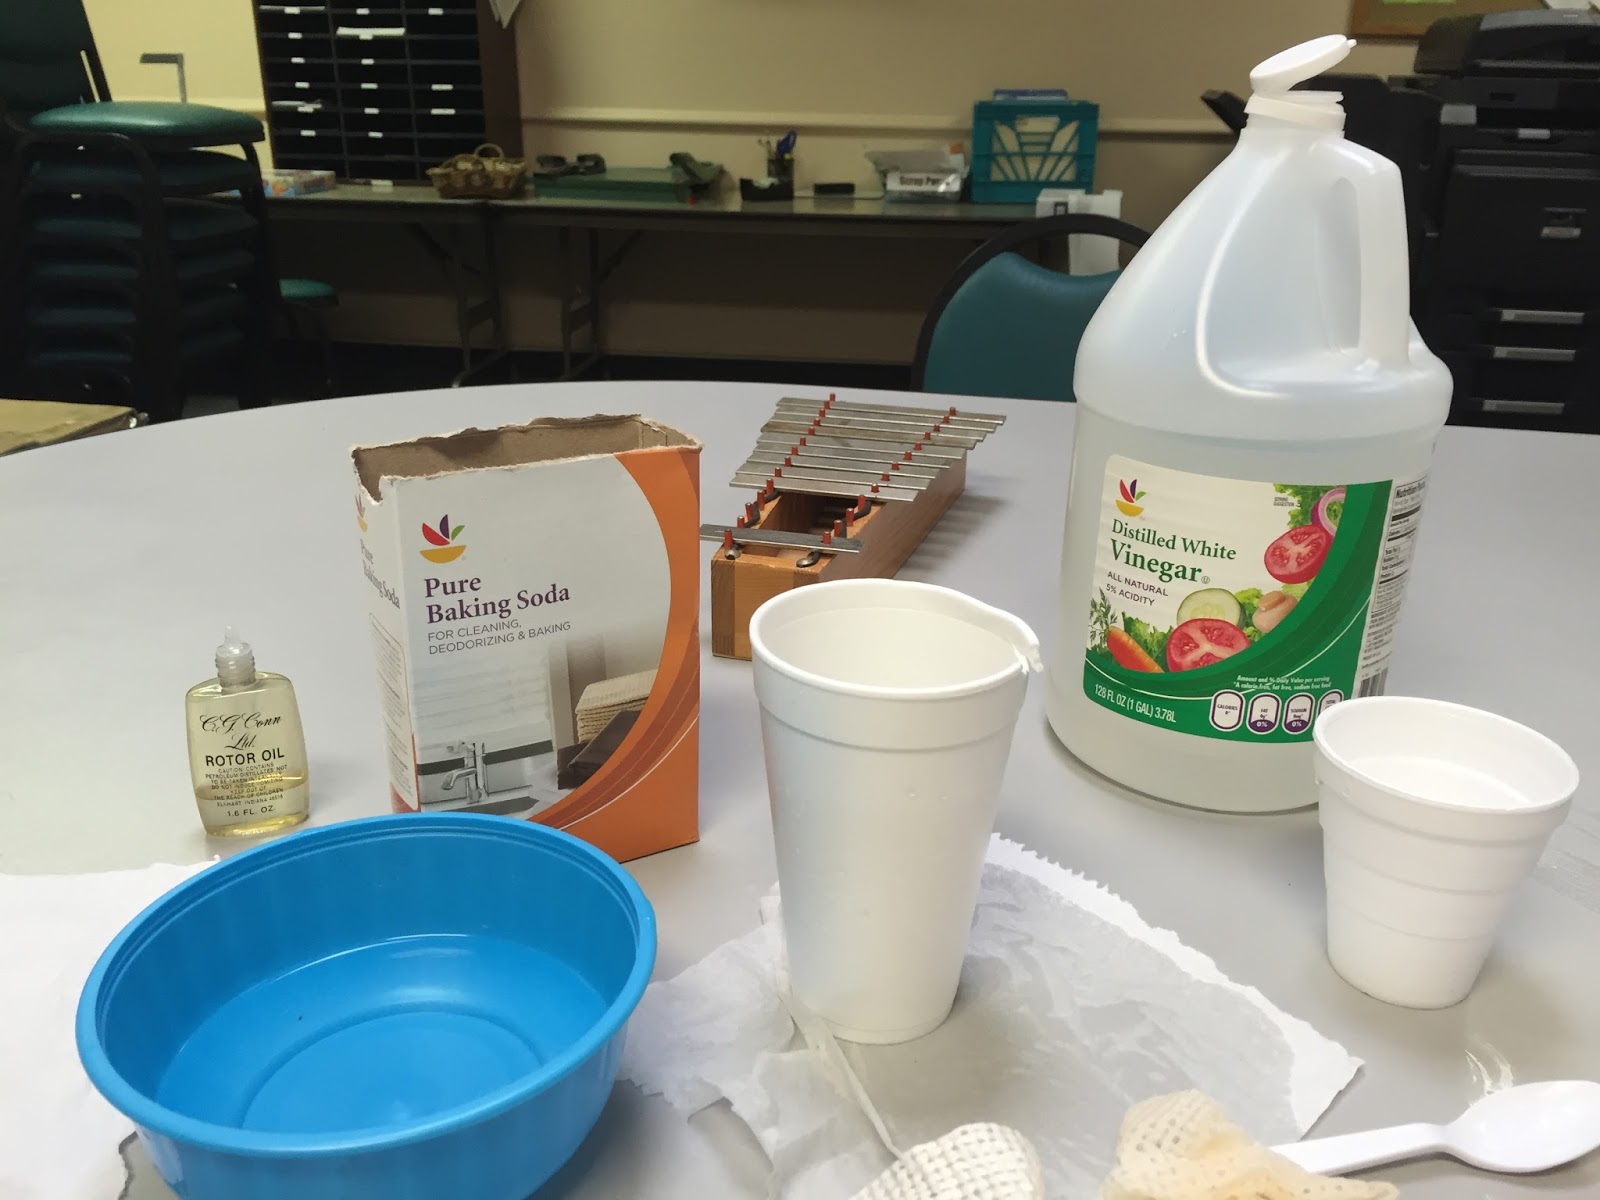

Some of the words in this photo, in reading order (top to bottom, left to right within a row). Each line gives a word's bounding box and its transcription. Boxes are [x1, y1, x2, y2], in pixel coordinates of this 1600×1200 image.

[1112, 518, 1176, 550] Distilled
[1181, 537, 1237, 560] White
[360, 538, 374, 565] Pure
[1111, 538, 1202, 583] Vinegar
[382, 580, 401, 610] Soda
[424, 577, 481, 598] Pure
[1106, 583, 1117, 594] 5%
[1118, 588, 1155, 606] ACIDITY
[1107, 571, 1122, 583] ALL
[1124, 577, 1169, 597] NATURAL
[426, 597, 511, 624] Baking
[516, 583, 571, 610] Soda
[428, 629, 454, 642] FOR
[457, 619, 522, 637] CLEANING,
[429, 632, 515, 654] DEODORIZING
[517, 630, 526, 640] &
[528, 621, 571, 638] BAKING
[1094, 684, 1107, 699] 128
[1106, 689, 1115, 703] FL
[1116, 693, 1126, 708] OZ
[1126, 697, 1134, 711] (1
[1135, 700, 1154, 718] GAL)
[1154, 706, 1177, 723] 3.78L
[242, 712, 281, 729] Conn
[1291, 720, 1302, 728] 0%
[224, 733, 257, 751] Ltd.
[205, 752, 256, 767] ROTOR
[261, 748, 285, 762] OIL
[246, 762, 274, 772] CONTAINS
[276, 764, 288, 772] NOT
[255, 788, 284, 797] CHILDREN
[260, 805, 276, 813] OZ.
